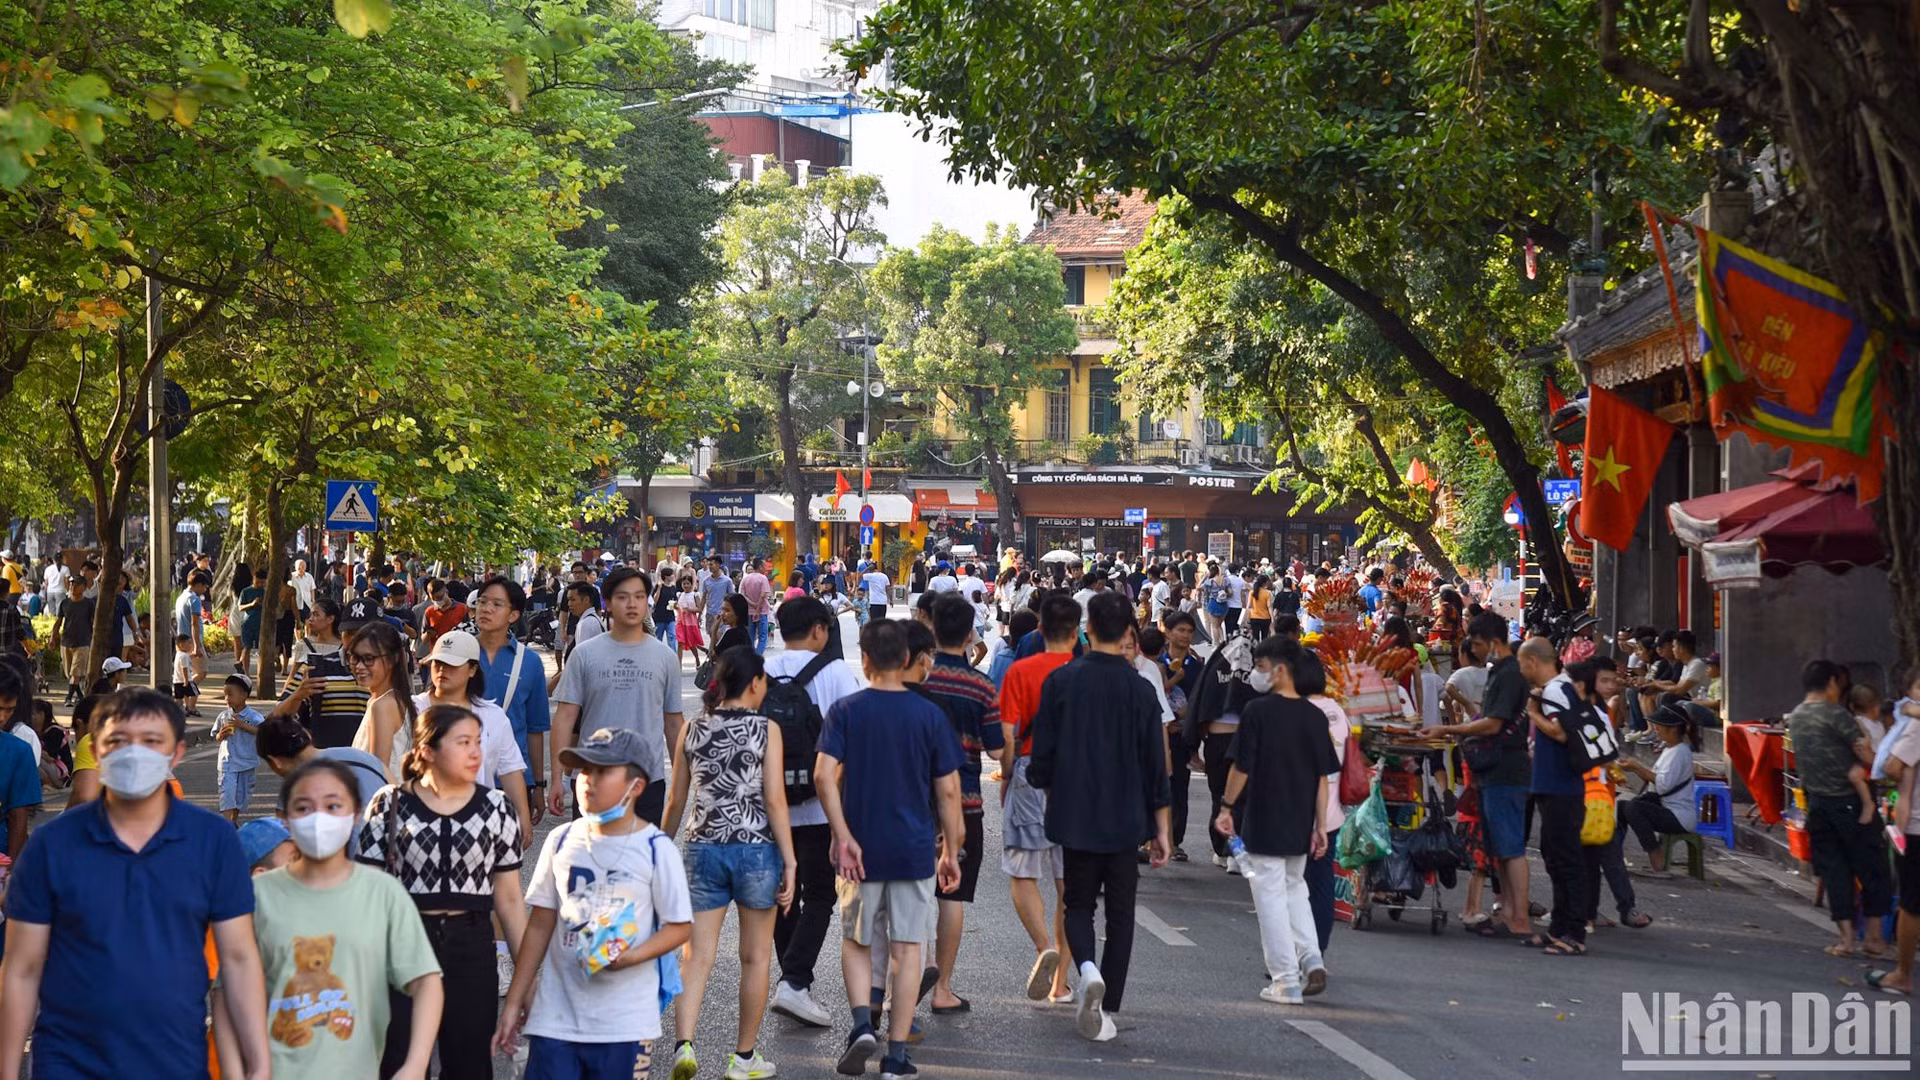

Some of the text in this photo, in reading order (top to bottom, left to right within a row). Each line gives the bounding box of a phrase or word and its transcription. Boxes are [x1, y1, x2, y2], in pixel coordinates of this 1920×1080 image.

[1032, 473, 1053, 482] CÔNG
[1097, 474, 1117, 482] SÁCH
[1118, 474, 1128, 482] HÀ
[1130, 474, 1143, 484] NỘI
[1189, 476, 1236, 488] POSTER
[1546, 489, 1560, 501] LÒ
[709, 506, 752, 517] Thanh Dung
[1080, 518, 1095, 526] 53
[598, 669, 653, 680] THE NORTH FACE
